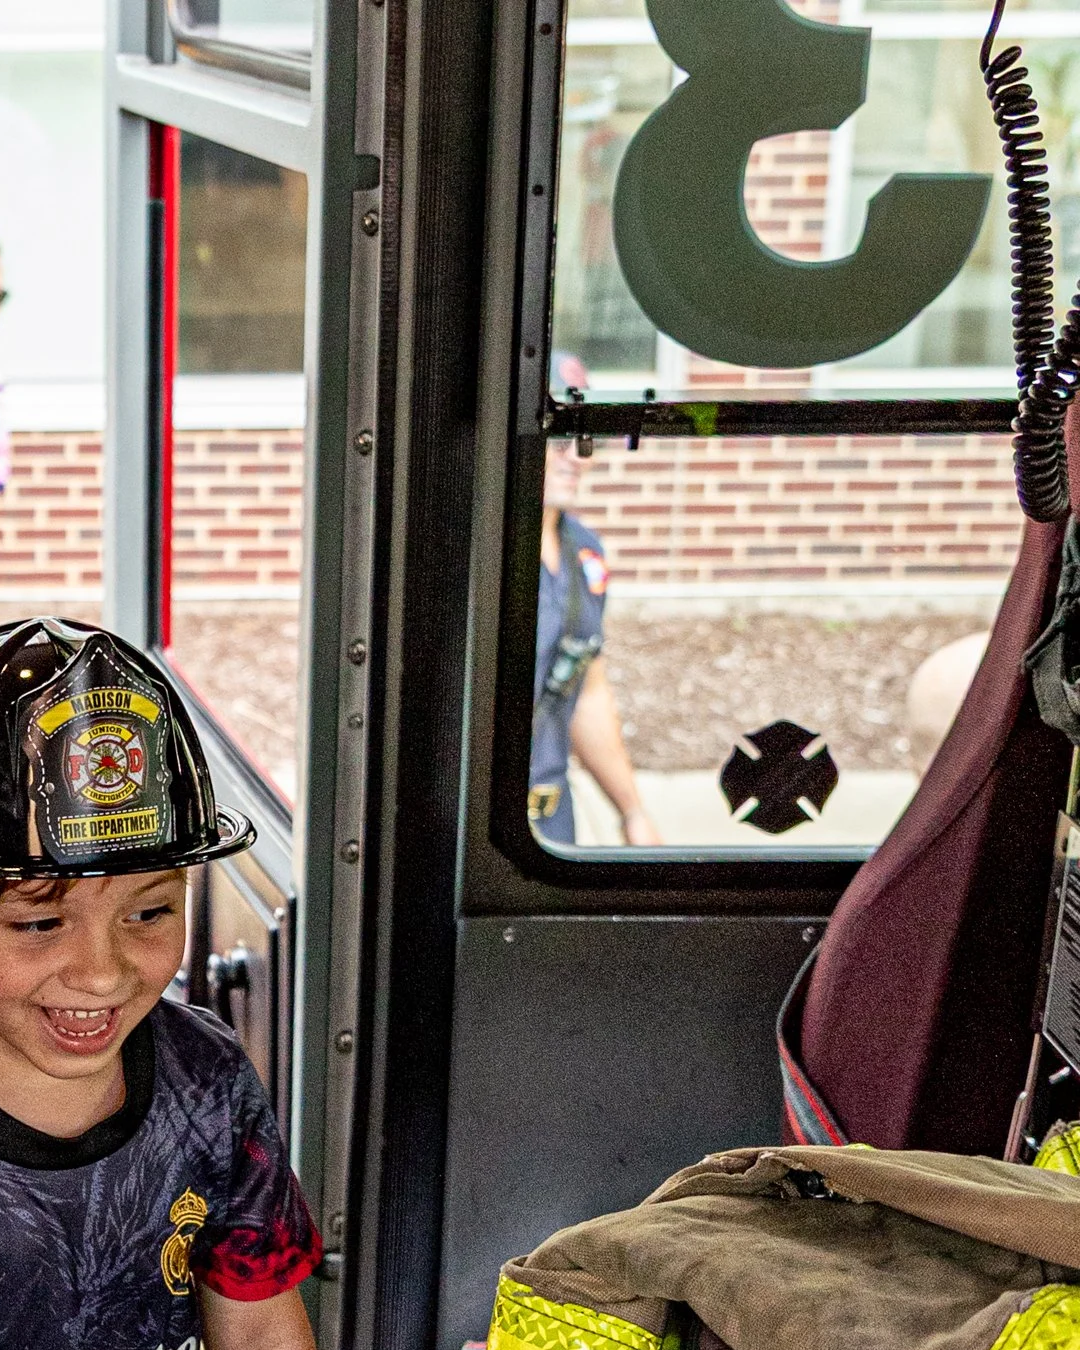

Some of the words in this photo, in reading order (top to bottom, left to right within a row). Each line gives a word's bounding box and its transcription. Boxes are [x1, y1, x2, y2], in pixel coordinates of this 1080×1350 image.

[71, 692, 132, 714] MADISON
[89, 726, 122, 738] JUNIOR
[129, 748, 143, 773] D
[85, 783, 133, 801] FIREFIGHTER
[63, 822, 87, 839] FIRE
[90, 814, 155, 836] DEPARTMENT
